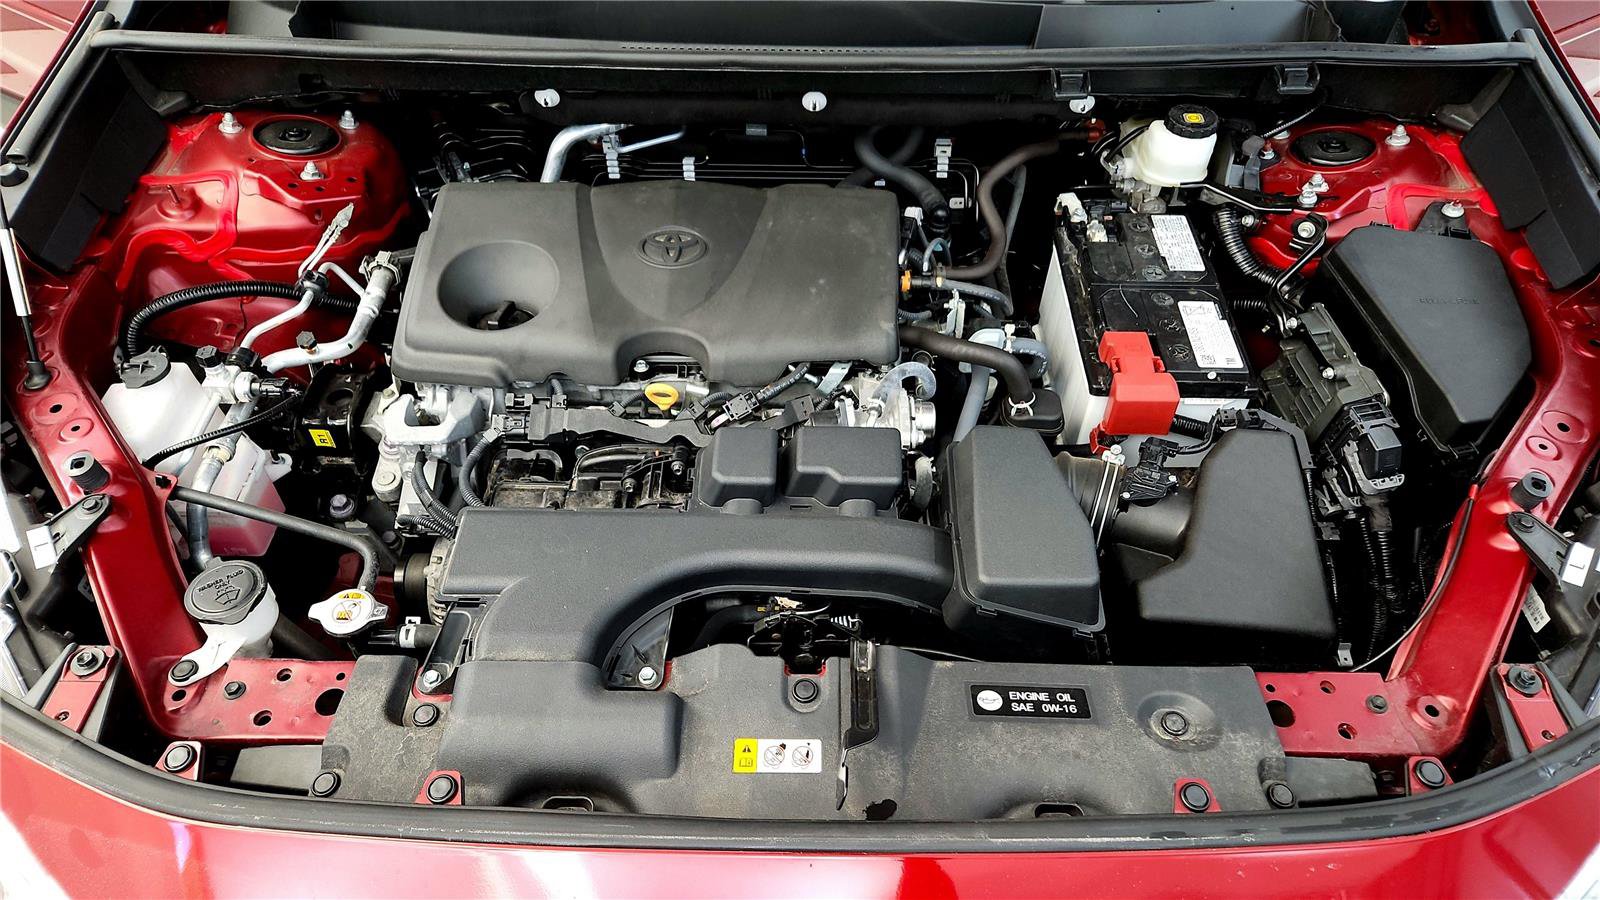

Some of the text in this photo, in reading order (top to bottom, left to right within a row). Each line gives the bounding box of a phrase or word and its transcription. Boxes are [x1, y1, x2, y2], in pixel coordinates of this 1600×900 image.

[317, 434, 328, 443] R1
[1008, 691, 1050, 702] ENGINE
[1056, 693, 1076, 703] OIL
[1011, 702, 1078, 714] SAE 0W-16
